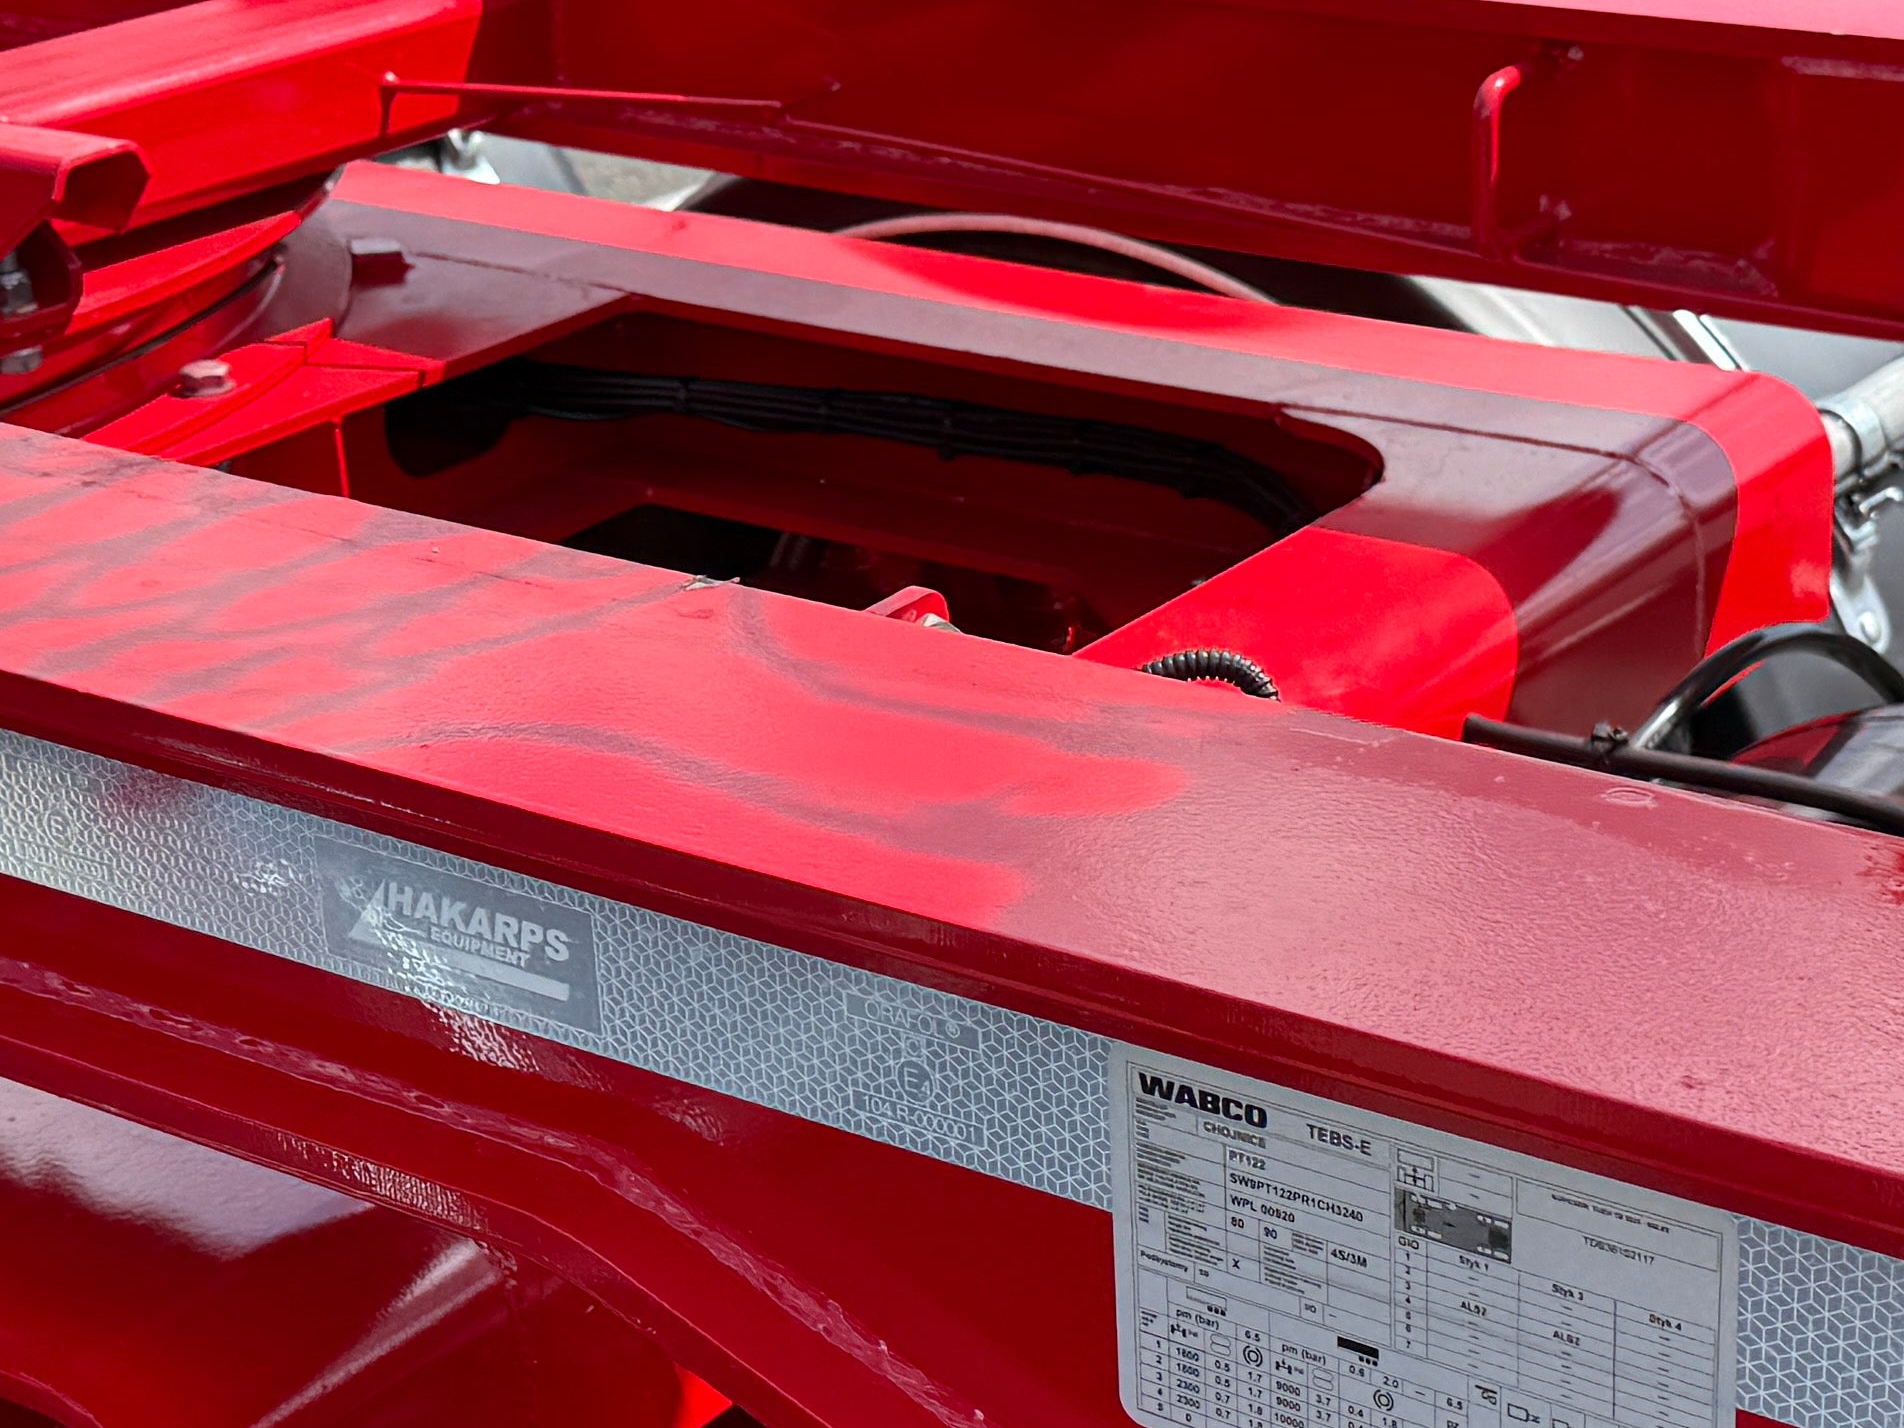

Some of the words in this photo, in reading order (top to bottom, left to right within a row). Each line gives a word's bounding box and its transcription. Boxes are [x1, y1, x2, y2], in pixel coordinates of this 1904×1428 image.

[387, 882, 570, 962] HAKARPS
[430, 925, 531, 968] EQUIPMENT
[865, 1000, 944, 1039] ORAFOL
[863, 1095, 894, 1117] 104
[1138, 1072, 1267, 1128] WABCO
[1306, 1123, 1371, 1156] TEBS-E
[1229, 1194, 1257, 1212] WPL
[1232, 1259, 1240, 1269] X
[1281, 1343, 1297, 1356] pm
[1301, 1348, 1326, 1366] (bar)
[1214, 1360, 1230, 1372] 0.5
[1214, 1375, 1231, 1388] 0.5
[1248, 1371, 1262, 1383] 1.7
[1383, 1376, 1399, 1389] 2.0
[1248, 1387, 1263, 1399] 1.7
[1276, 1380, 1301, 1397] 9000
[1215, 1392, 1230, 1403] 0.7
[1276, 1396, 1301, 1412] 9000
[1316, 1394, 1331, 1406] 3.7
[1216, 1407, 1231, 1419] 0.7
[1316, 1410, 1331, 1422] 3.7
[1347, 1405, 1364, 1418] 0.4
